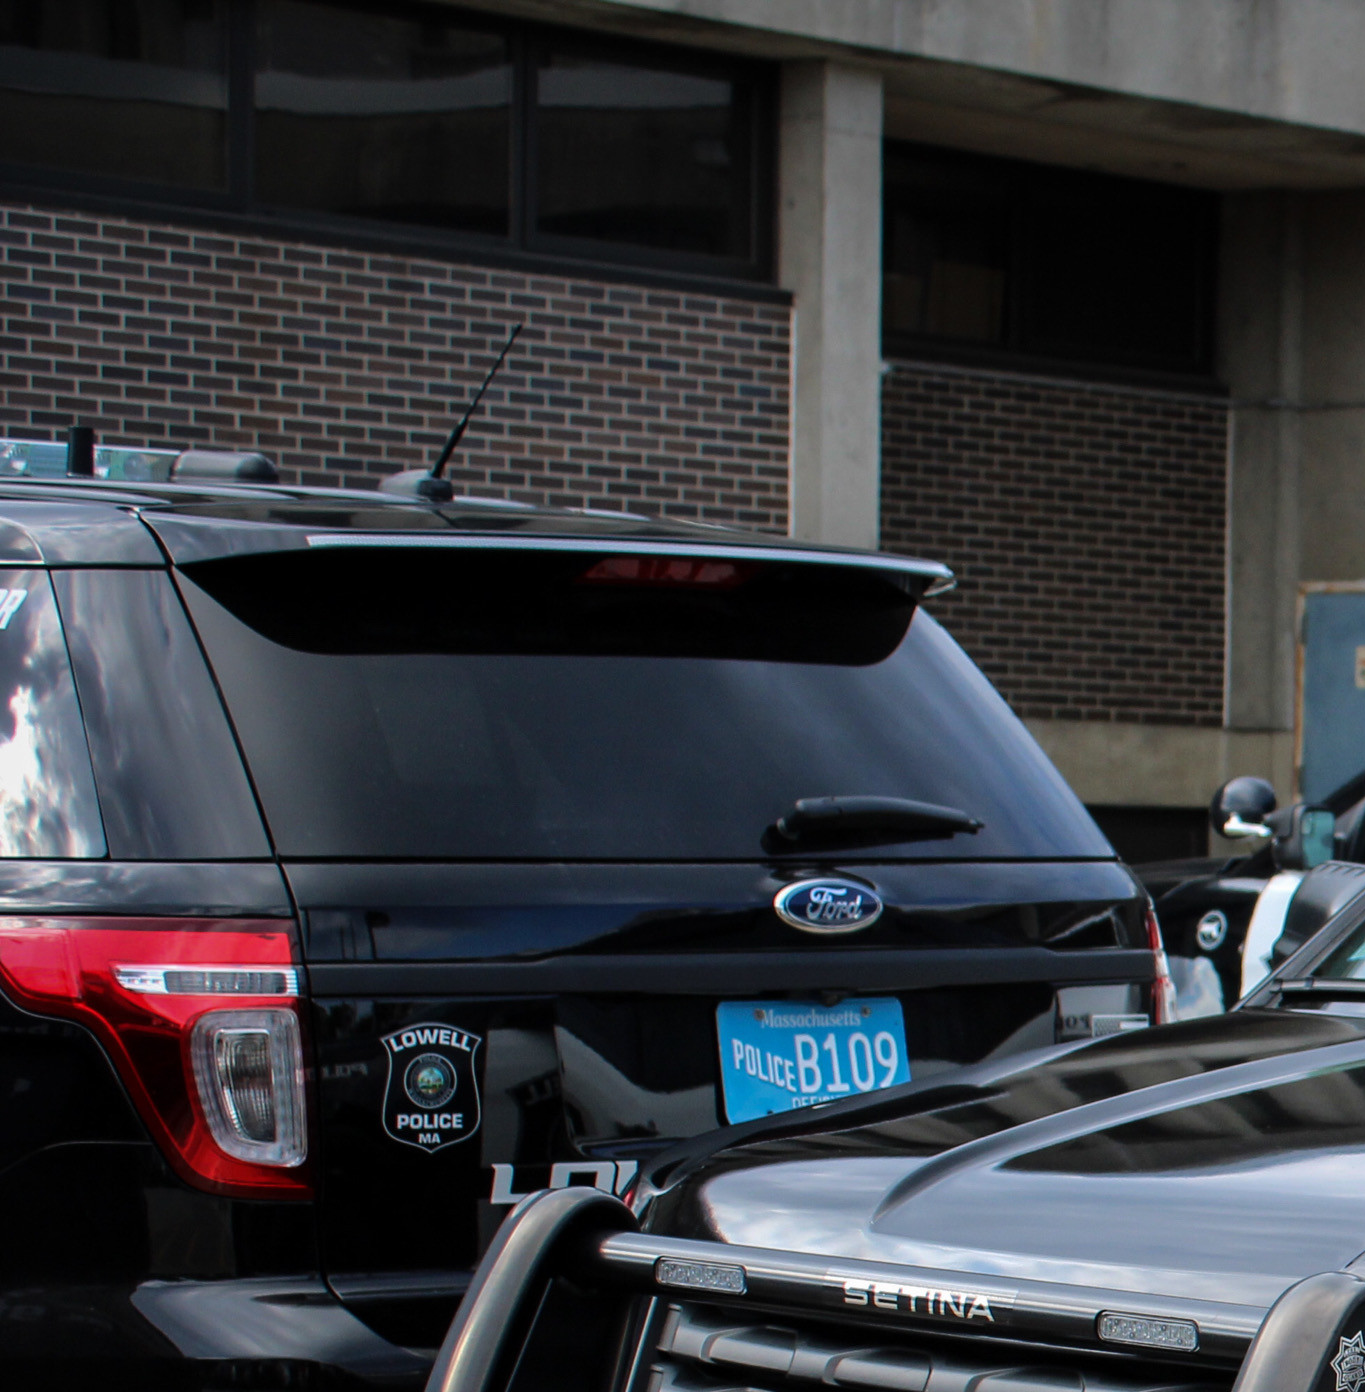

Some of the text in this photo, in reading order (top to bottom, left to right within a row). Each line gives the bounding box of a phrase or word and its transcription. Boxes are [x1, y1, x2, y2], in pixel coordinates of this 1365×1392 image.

[804, 887, 863, 923] Ford
[761, 1008, 861, 1029] Massachusetts
[390, 1028, 471, 1052] LOWELL
[732, 1031, 898, 1093] POLICE B109
[397, 1113, 464, 1129] POLICE
[418, 1132, 441, 1144] MA
[842, 1278, 996, 1323] SETINA
